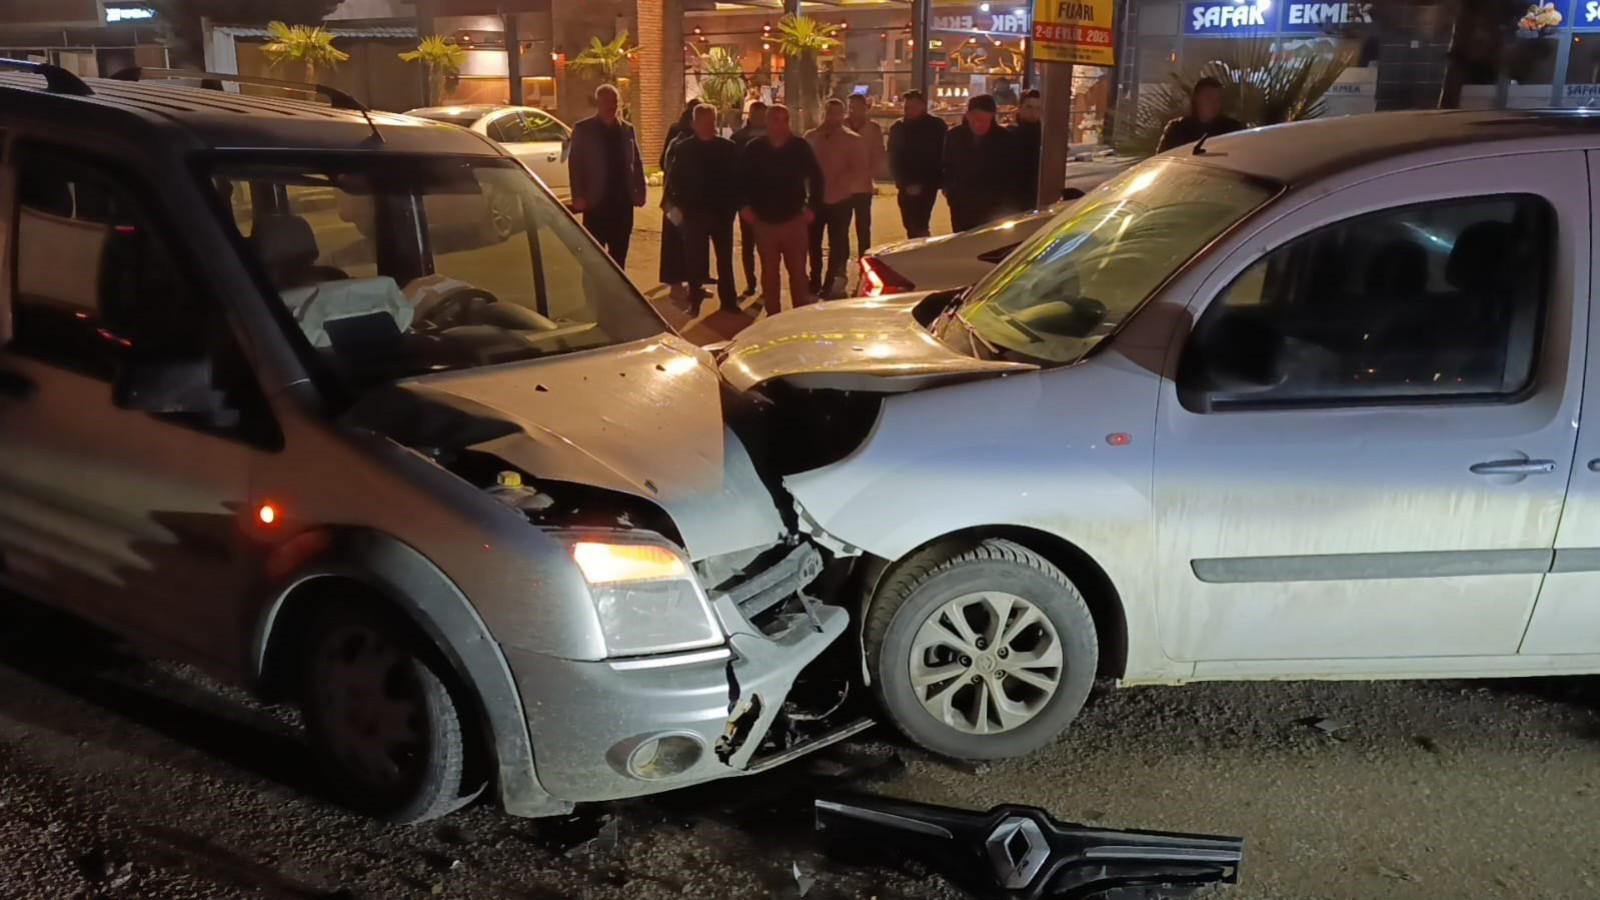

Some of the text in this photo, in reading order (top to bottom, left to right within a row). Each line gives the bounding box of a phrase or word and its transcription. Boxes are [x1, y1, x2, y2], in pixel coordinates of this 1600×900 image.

[1058, 2, 1094, 22] FUARI
[1192, 3, 1373, 31] ŞAFAK EKMEK
[1584, 1, 1600, 22] Ş
[1086, 29, 1110, 43] 2025
